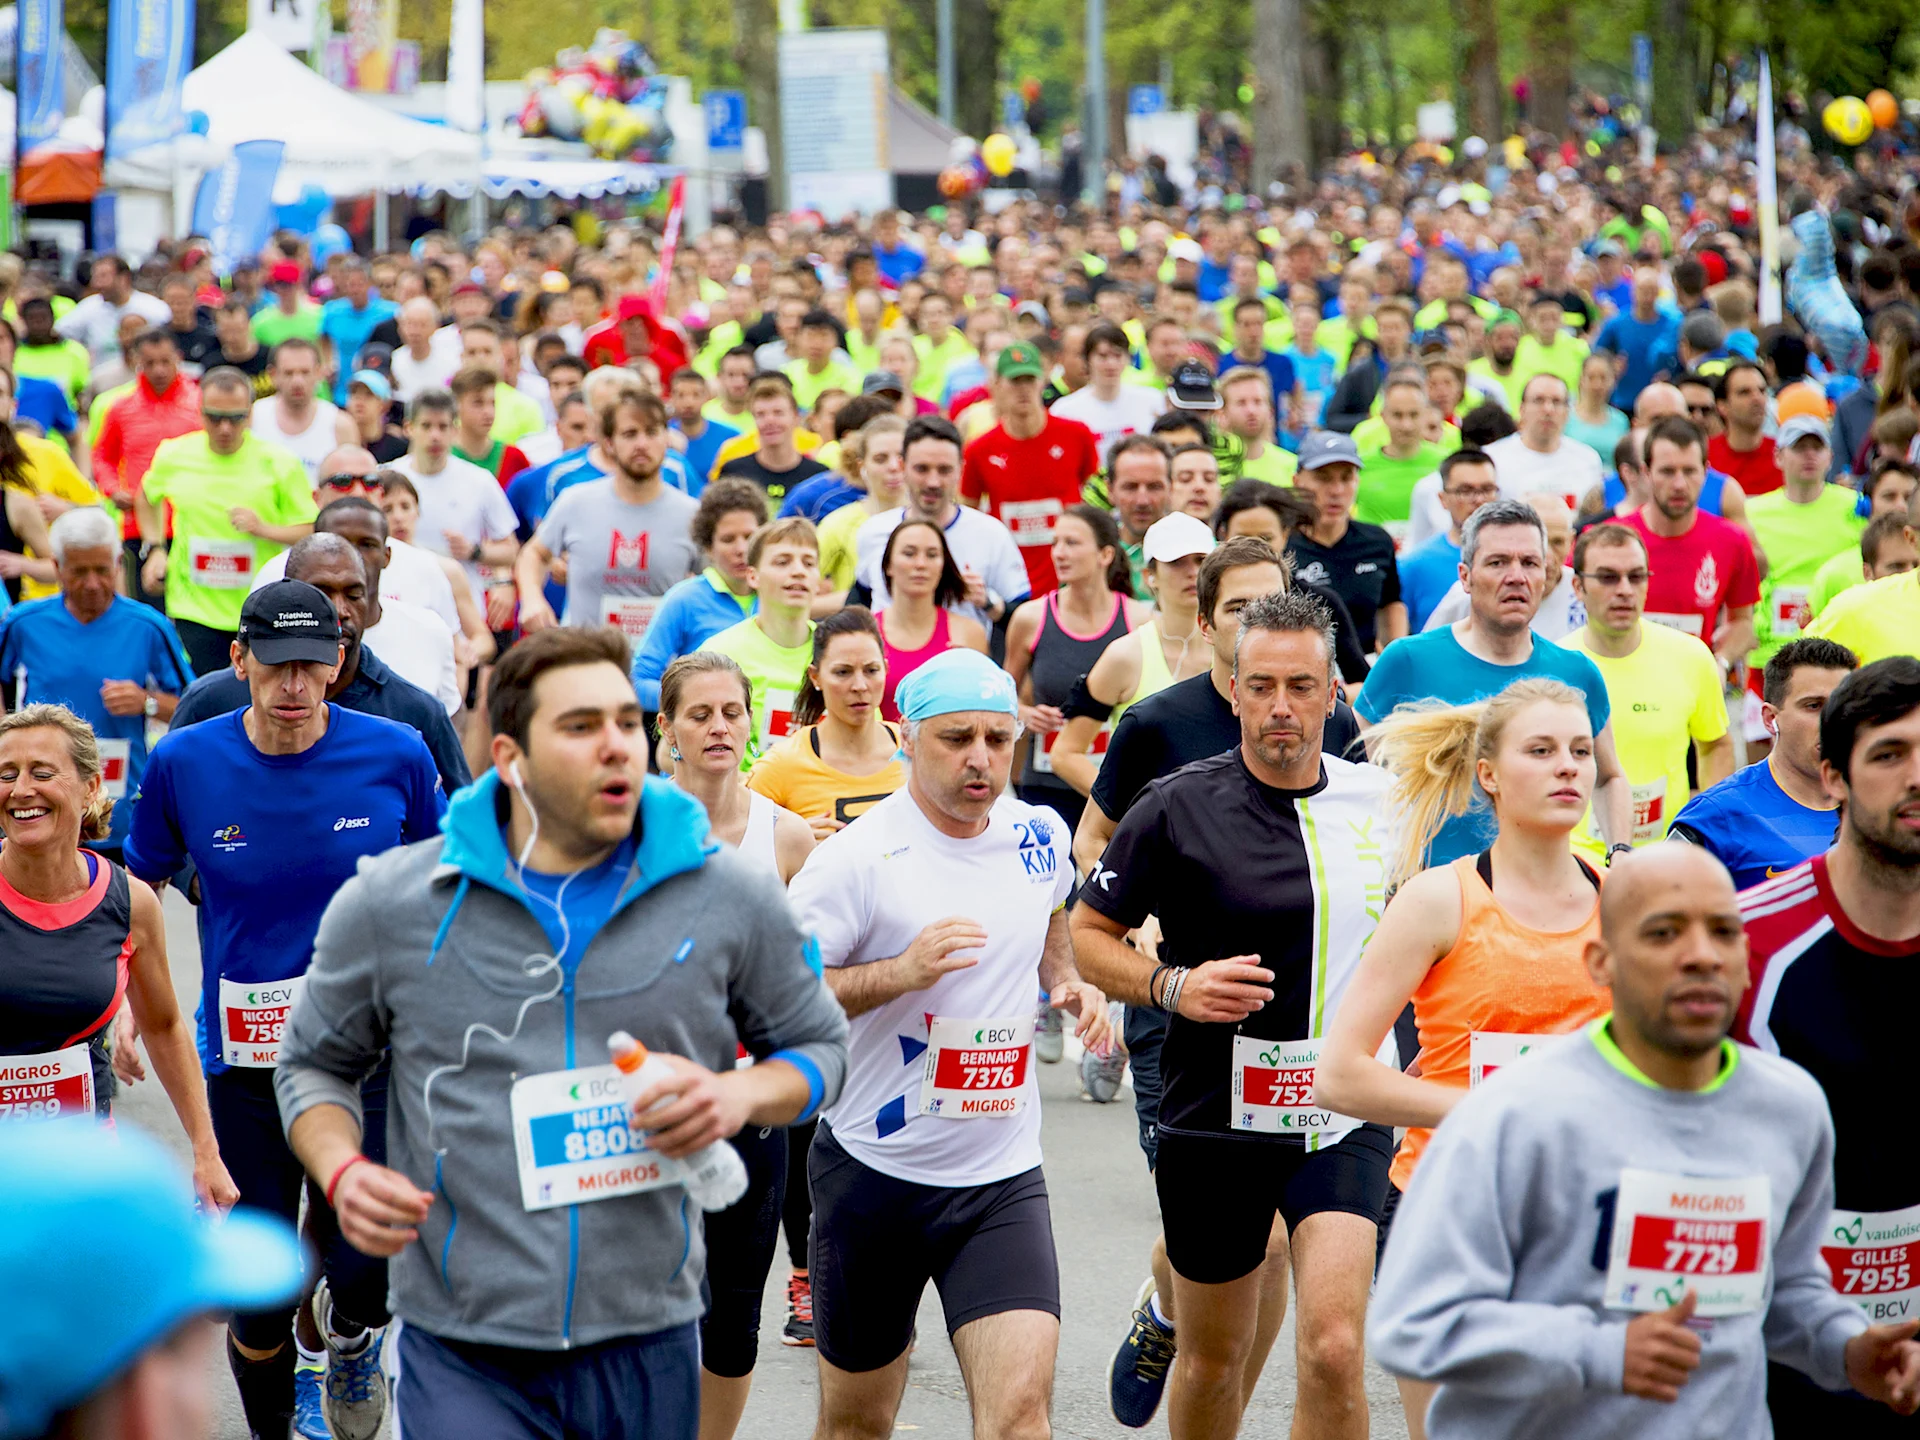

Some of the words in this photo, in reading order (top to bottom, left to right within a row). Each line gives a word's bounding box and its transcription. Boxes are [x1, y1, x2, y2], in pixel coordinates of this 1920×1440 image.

[272, 619, 320, 629] Schwarzsee
[278, 611, 313, 621] Triathlon
[345, 817, 370, 829] asics
[1019, 847, 1057, 875] KM
[1346, 815, 1385, 961] VIUK
[261, 989, 292, 1004] BCV
[988, 1028, 1015, 1043] BCV
[959, 1050, 1020, 1066] BERNARD
[590, 1077, 622, 1097] BC
[962, 1065, 1015, 1089] 7376
[2, 1084, 55, 1101] SYLVIE
[0, 1098, 61, 1120] 7589
[961, 1098, 1015, 1112] MIGROS
[1297, 1112, 1330, 1128] BCV
[577, 1161, 660, 1190] MIGROS
[1669, 1192, 1744, 1213] MIGROS
[1673, 1219, 1736, 1243] PIERRE
[1663, 1241, 1737, 1274] 7729
[1850, 1246, 1906, 1266] GILLES
[1842, 1264, 1910, 1293] 7955
[1695, 1289, 1744, 1306] audoise
[1874, 1299, 1910, 1320] BCV
